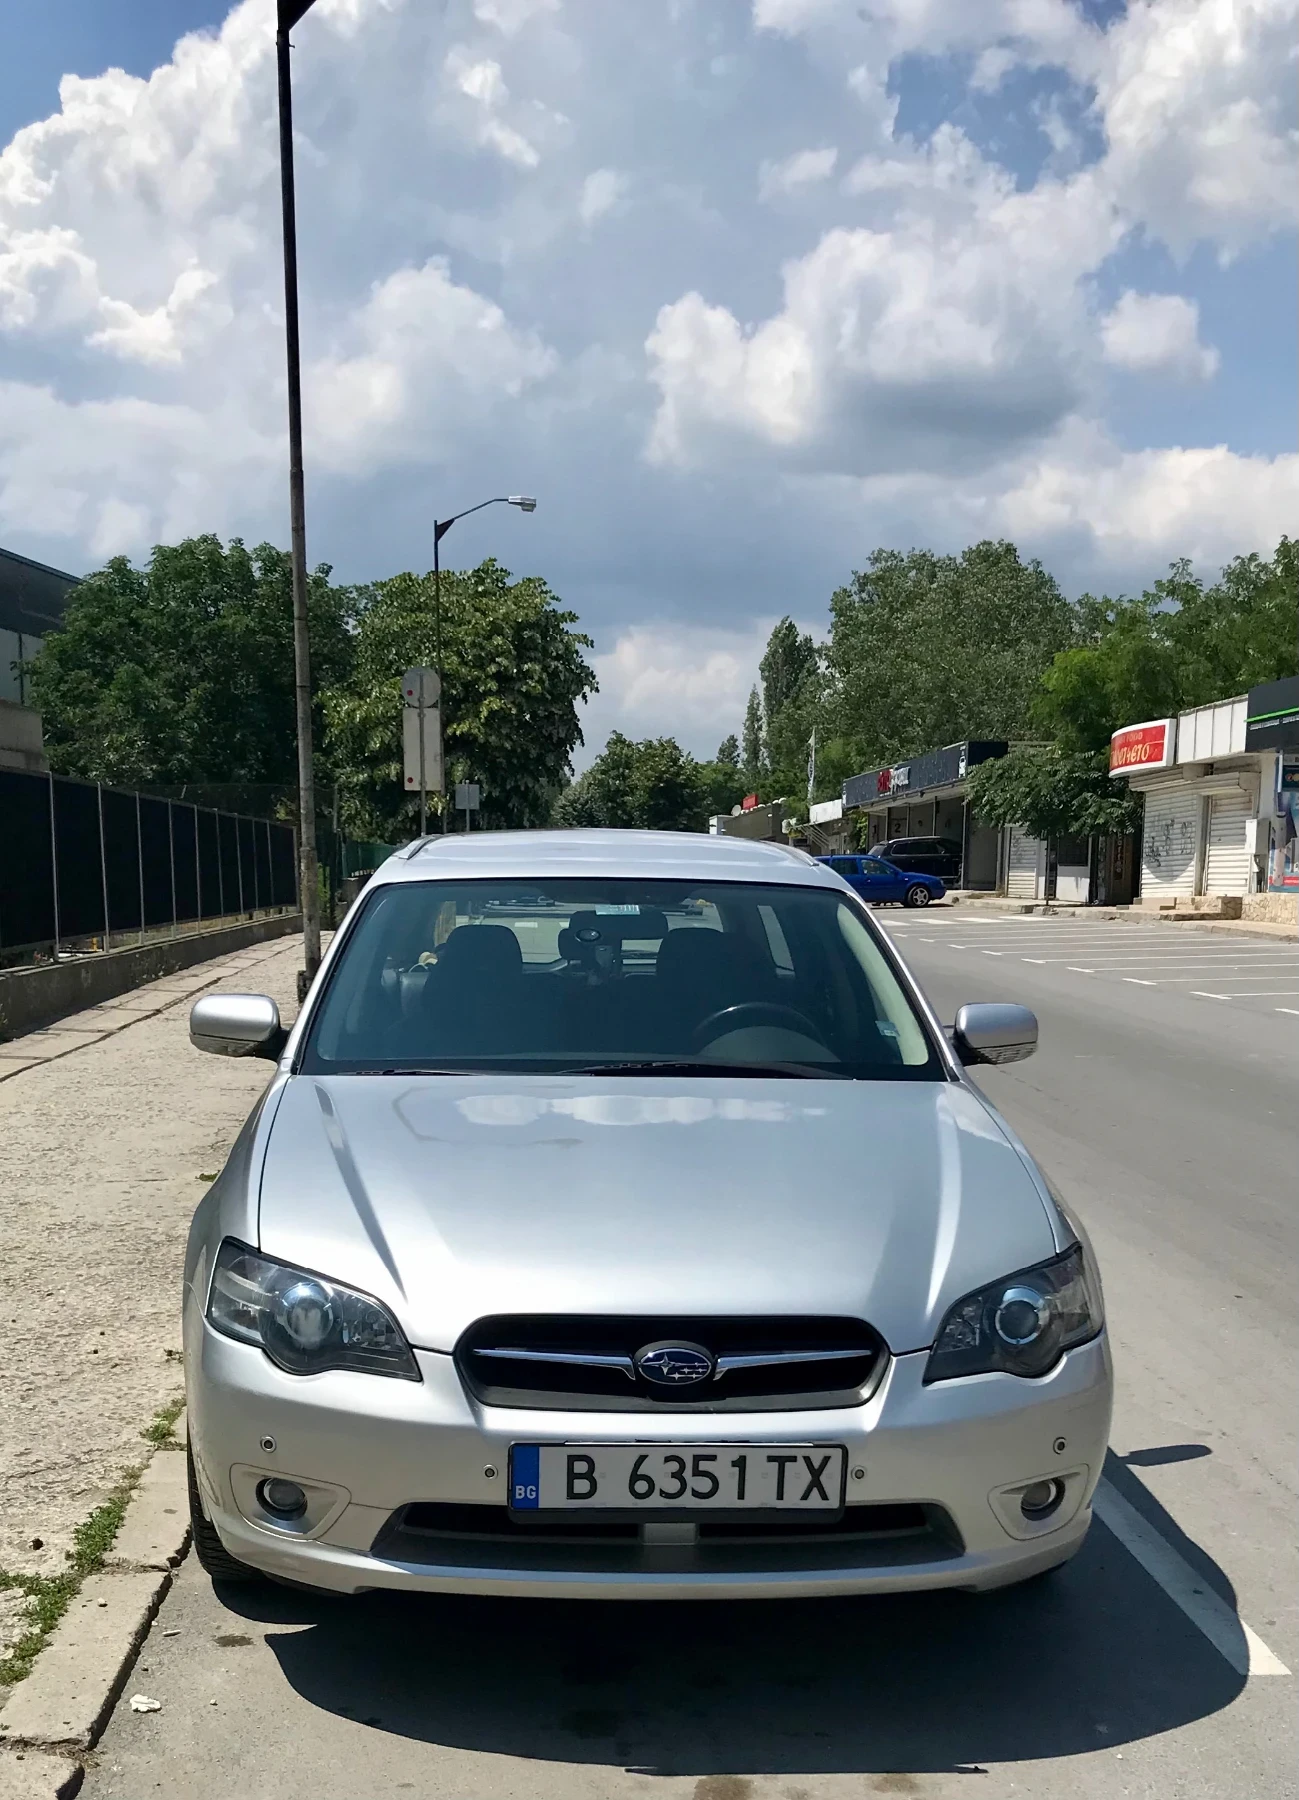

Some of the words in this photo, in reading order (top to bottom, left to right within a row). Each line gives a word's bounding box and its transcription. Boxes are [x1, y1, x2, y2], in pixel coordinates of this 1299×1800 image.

[515, 1485, 537, 1500] BG
[566, 1454, 597, 1500] B
[628, 1454, 747, 1501] 6351
[766, 1455, 832, 1501] TX
